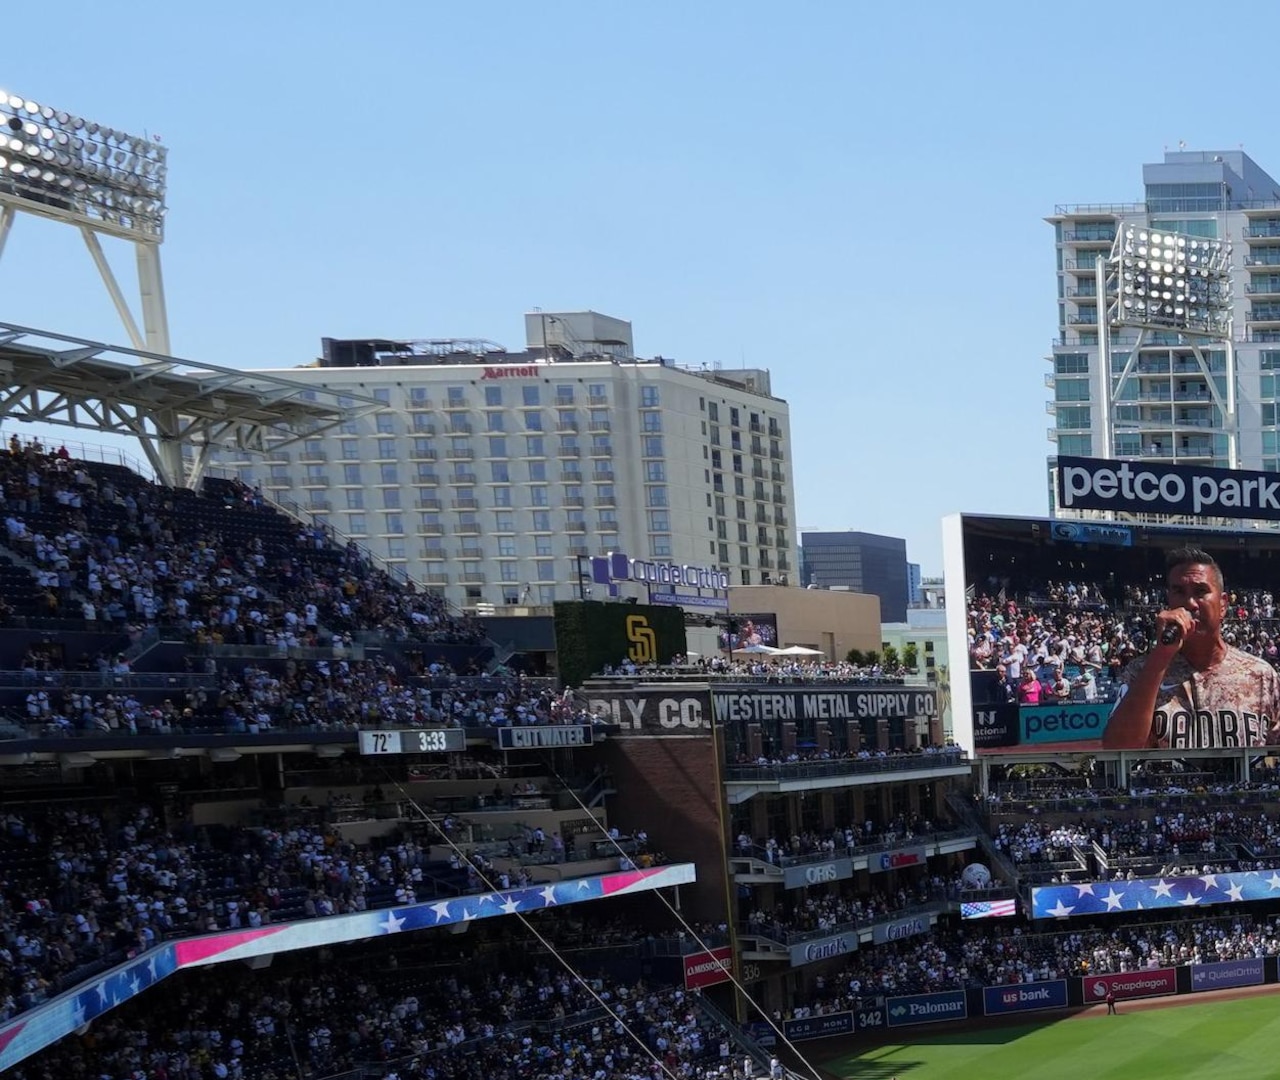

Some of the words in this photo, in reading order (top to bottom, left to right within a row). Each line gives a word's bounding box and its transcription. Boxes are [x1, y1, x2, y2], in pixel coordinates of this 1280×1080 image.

[481, 366, 538, 379] Marriott
[1063, 462, 1186, 505] petco
[1193, 471, 1280, 513] park
[659, 698, 711, 729] CO.
[714, 693, 797, 721] WESTERN
[803, 692, 854, 719] METAL
[856, 692, 909, 718] SUPPLY
[914, 692, 938, 716] CO.
[1026, 709, 1100, 739] petco
[419, 732, 446, 752] 3:33
[511, 727, 584, 747] CUTWATER
[743, 963, 760, 981] 336
[1209, 967, 1261, 981] QuidelOrtho
[1112, 977, 1167, 992] Snapdragon
[1003, 991, 1018, 1003] us
[1019, 987, 1050, 1001] bank
[909, 1001, 964, 1016] Palomar
[859, 1012, 882, 1027] 342
